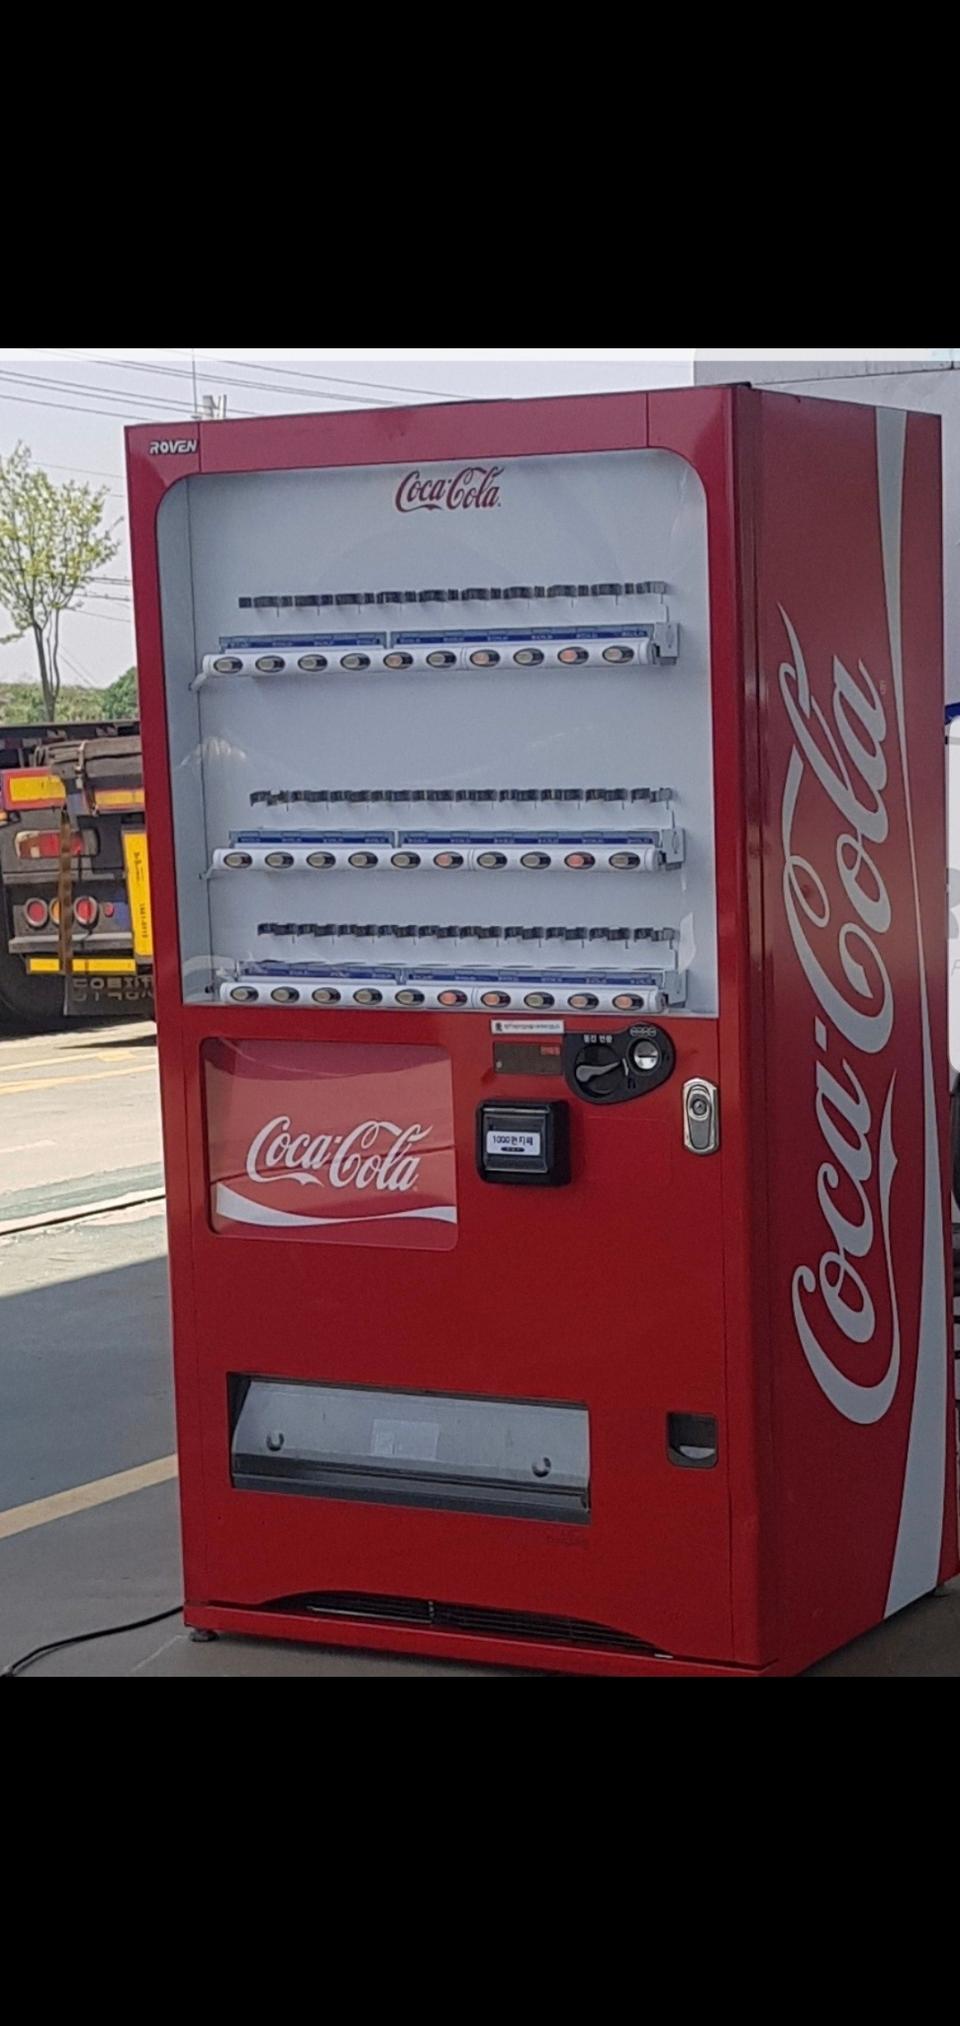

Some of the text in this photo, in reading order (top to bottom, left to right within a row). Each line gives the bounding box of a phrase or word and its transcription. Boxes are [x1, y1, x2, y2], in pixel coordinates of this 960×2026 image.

[149, 439, 198, 455] ROVEN
[395, 465, 505, 513] Coca-Cola
[776, 601, 901, 1425] Coca-Cola
[246, 1116, 433, 1192] Coca-Cola
